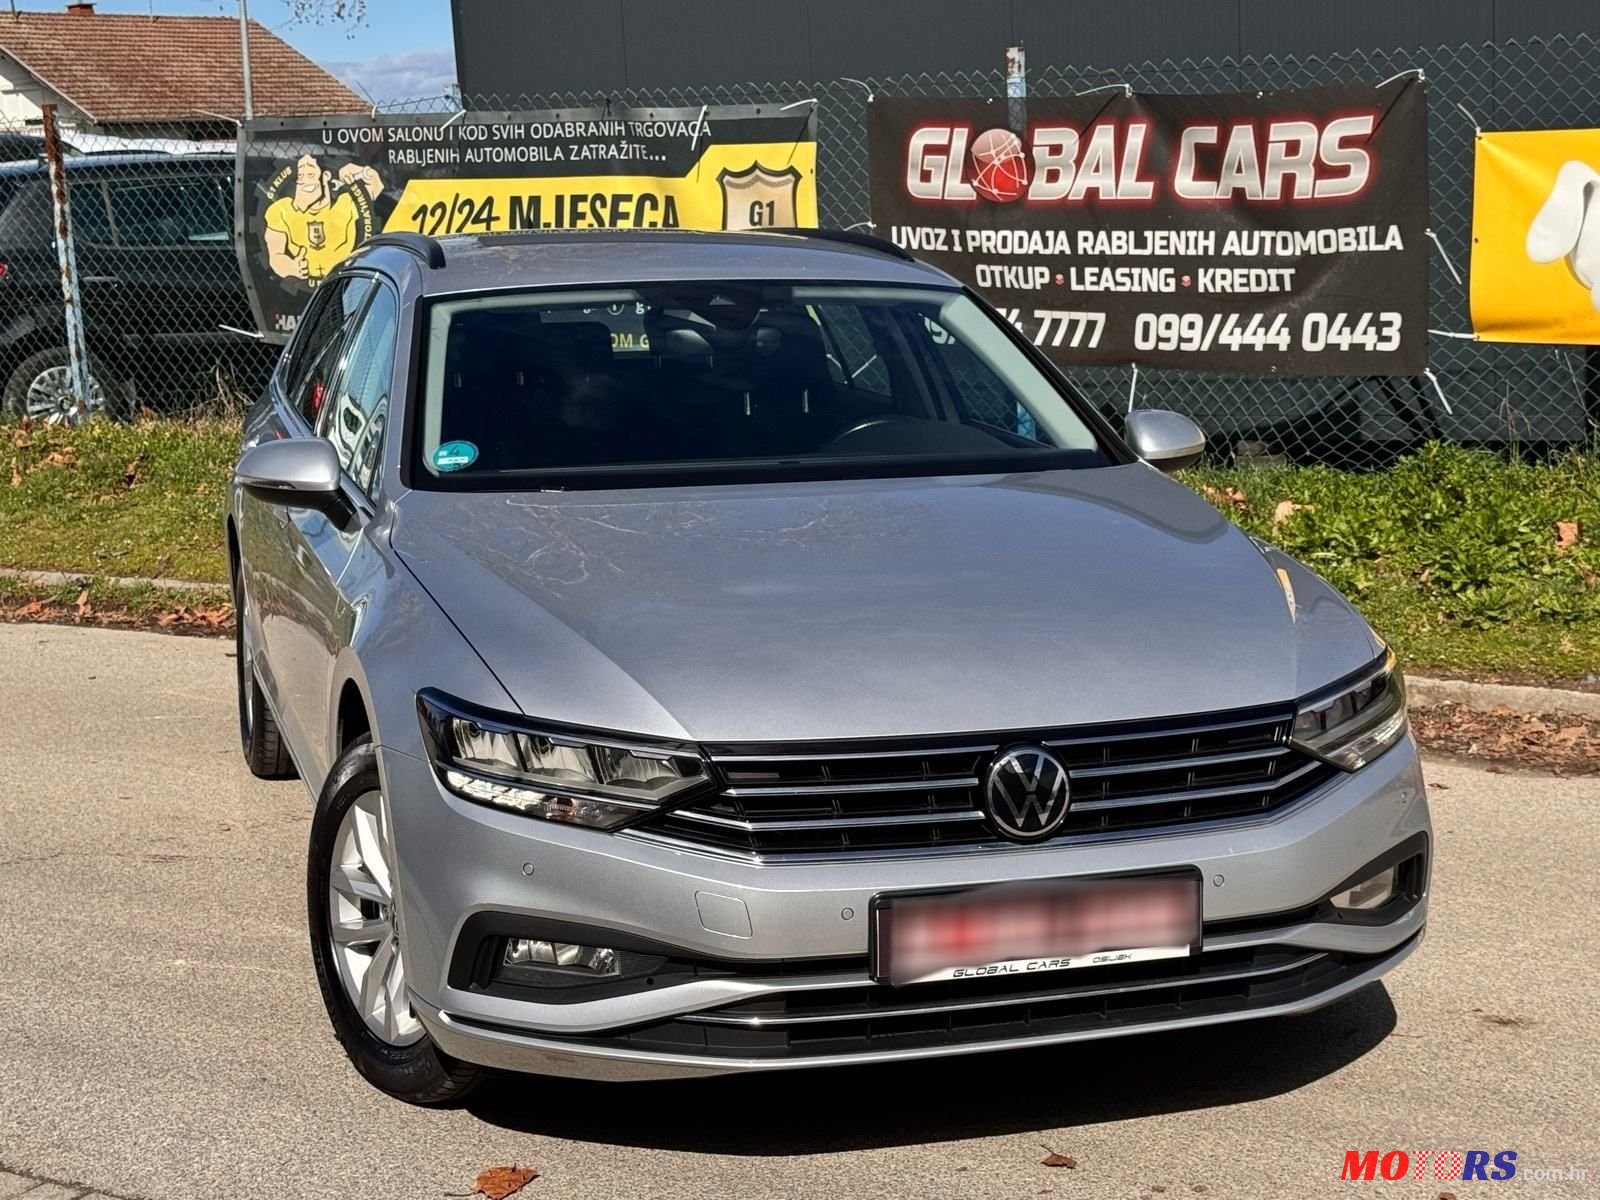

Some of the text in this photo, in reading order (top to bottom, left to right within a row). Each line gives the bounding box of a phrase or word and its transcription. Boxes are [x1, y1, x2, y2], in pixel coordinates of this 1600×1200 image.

[322, 129, 332, 144] U
[337, 127, 384, 144] OVOM
[388, 126, 444, 143] SALONU
[449, 126, 454, 141] I
[458, 125, 488, 141] KOD
[493, 123, 525, 140] SVIH
[530, 121, 626, 139] ODABRANIH
[388, 140, 667, 167] RABLJENIH AUTOMOBILA ZATRAŽITE...
[907, 115, 1374, 200] GLOBAL CARS
[411, 193, 501, 236] 12/24
[749, 200, 775, 227] G1
[891, 225, 1404, 256] UVOZ I PRODAJA RABLJENIH AUTOMOBILA
[975, 264, 1296, 293] OTKUP LEASING KREDIT
[1033, 309, 1106, 348] 7777
[1134, 312, 1291, 351] 099/444
[1301, 311, 1403, 352] 0443
[952, 965, 1020, 978] GLOBAL
[1026, 958, 1072, 972] CARS
